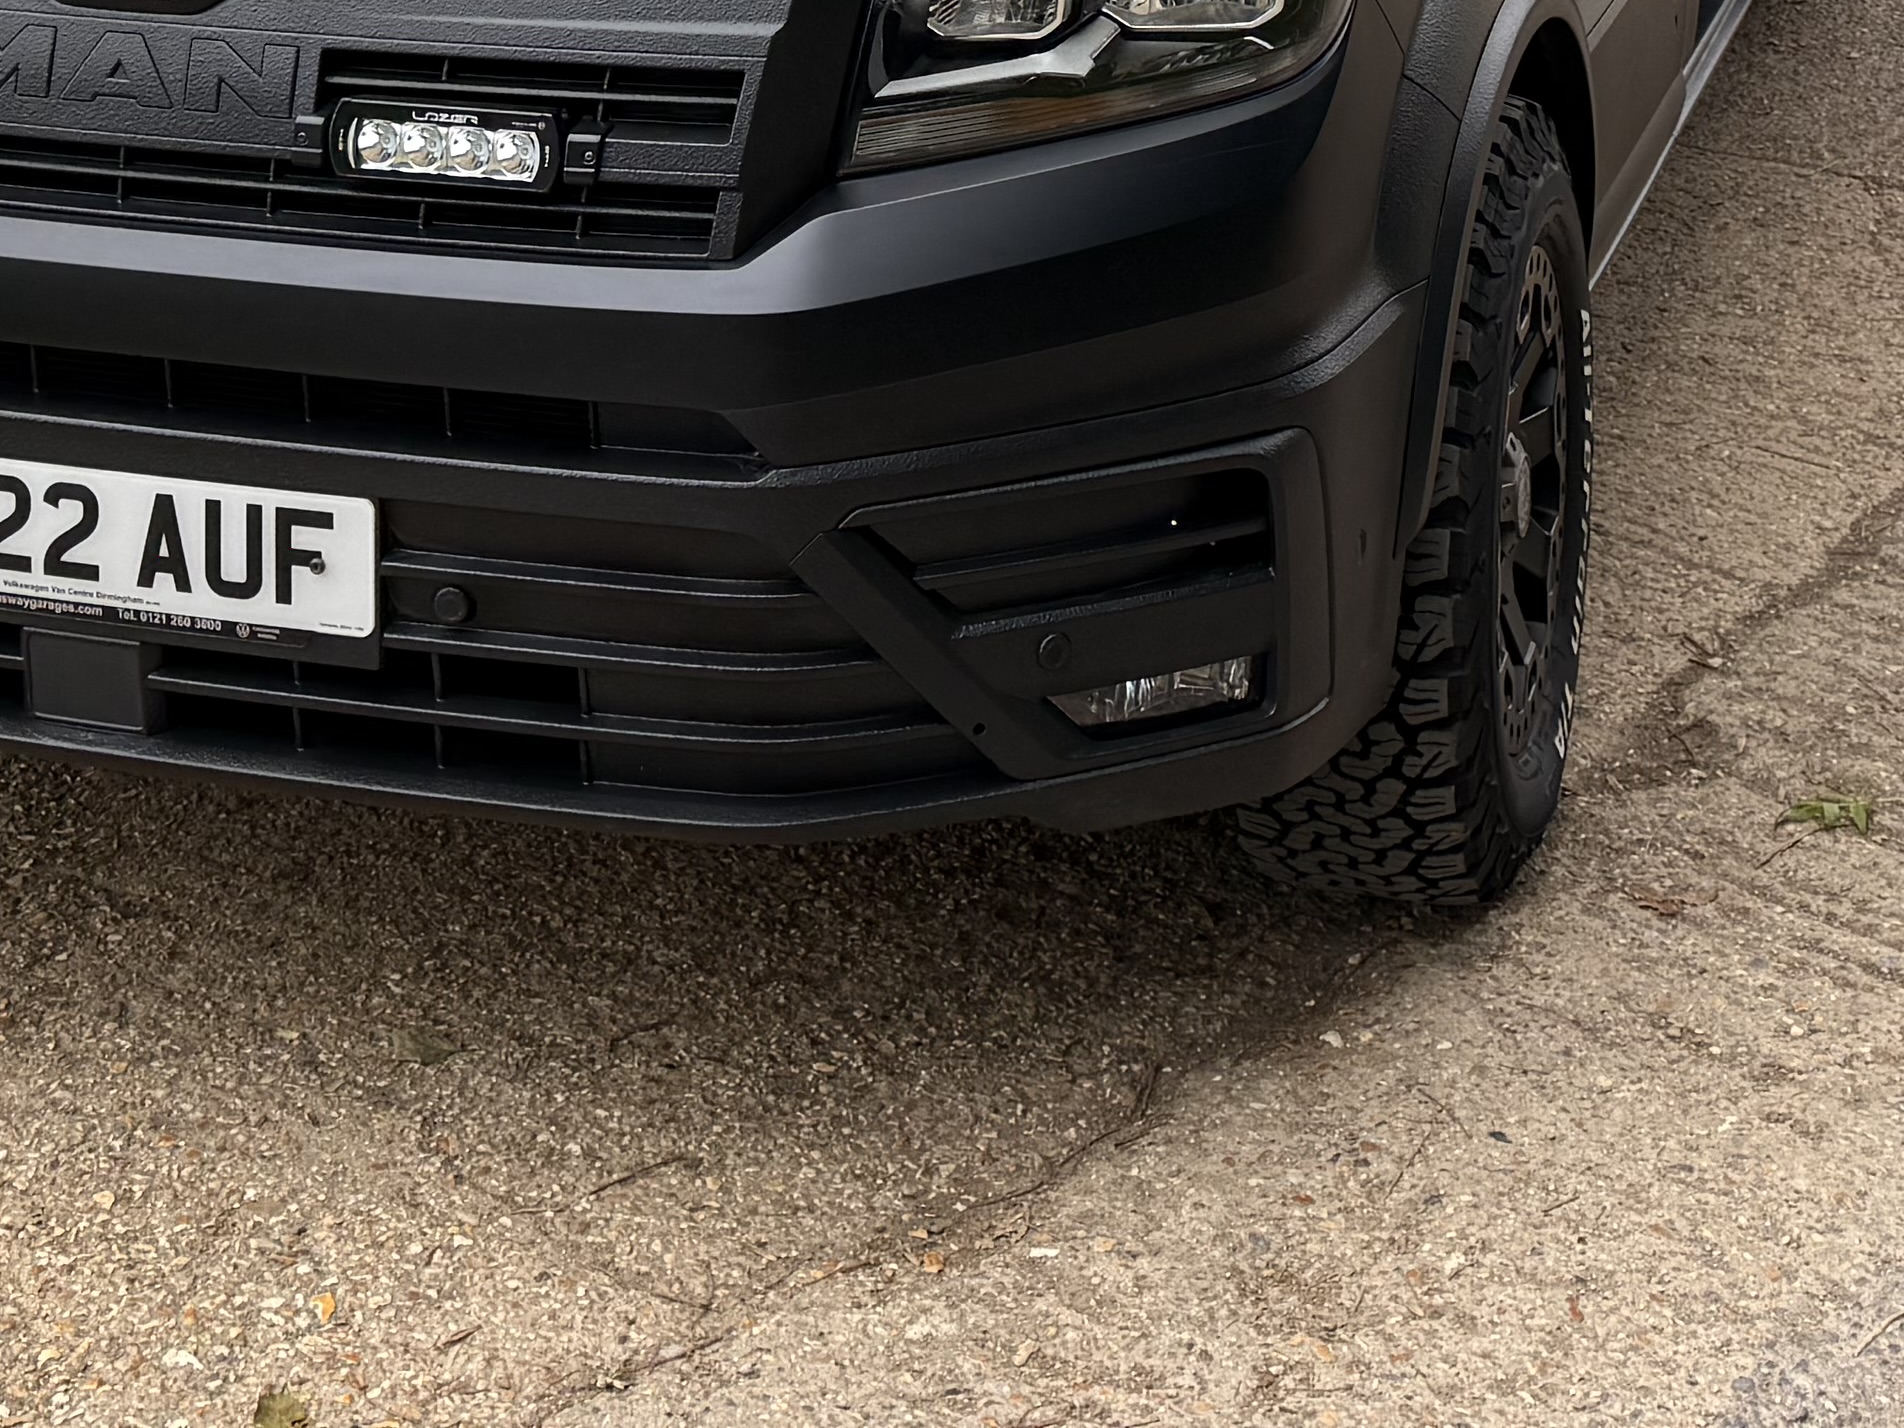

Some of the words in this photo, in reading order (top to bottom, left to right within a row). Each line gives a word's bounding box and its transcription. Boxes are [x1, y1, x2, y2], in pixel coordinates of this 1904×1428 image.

[412, 110, 478, 125] LAZER
[1571, 309, 1593, 655] All-Terrain
[136, 493, 334, 605] AUF
[140, 611, 167, 625] 0121
[1554, 682, 1574, 759] T/A
